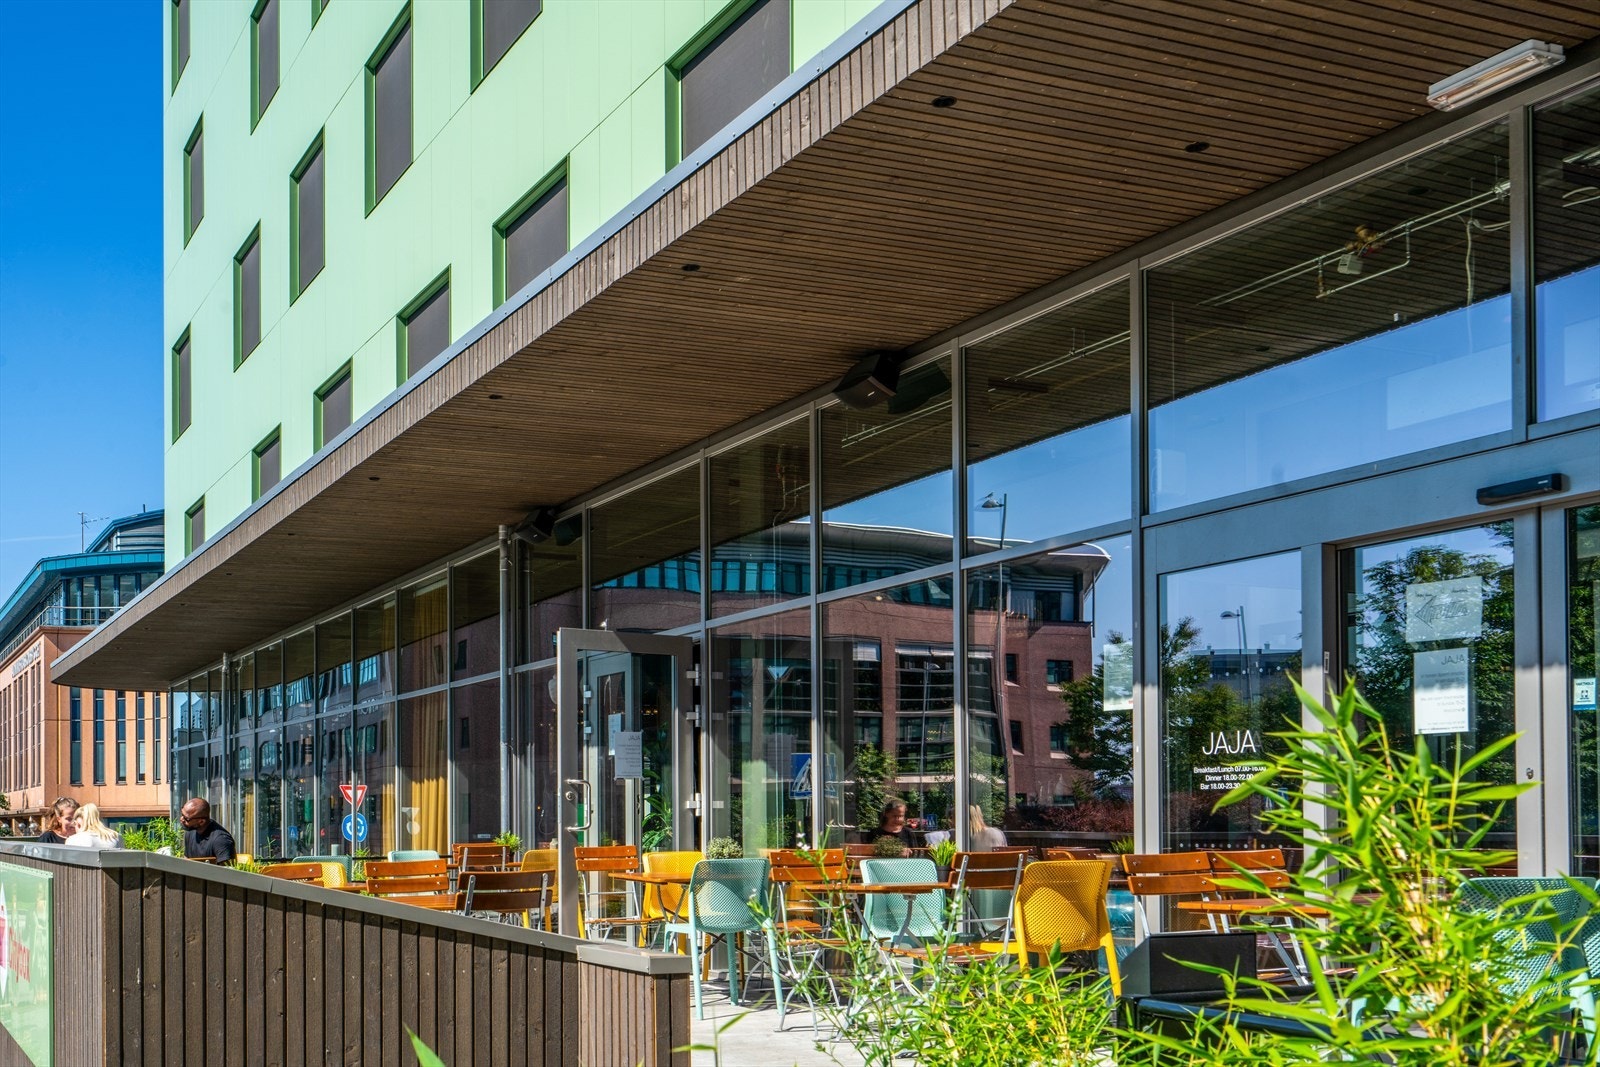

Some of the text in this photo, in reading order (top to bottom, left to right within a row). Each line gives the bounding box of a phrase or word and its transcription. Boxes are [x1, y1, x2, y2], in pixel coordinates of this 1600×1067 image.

[1202, 730, 1256, 755] JAJA
[1193, 766, 1234, 774] Breakfast/Lunch
[1205, 774, 1222, 782] Dinner
